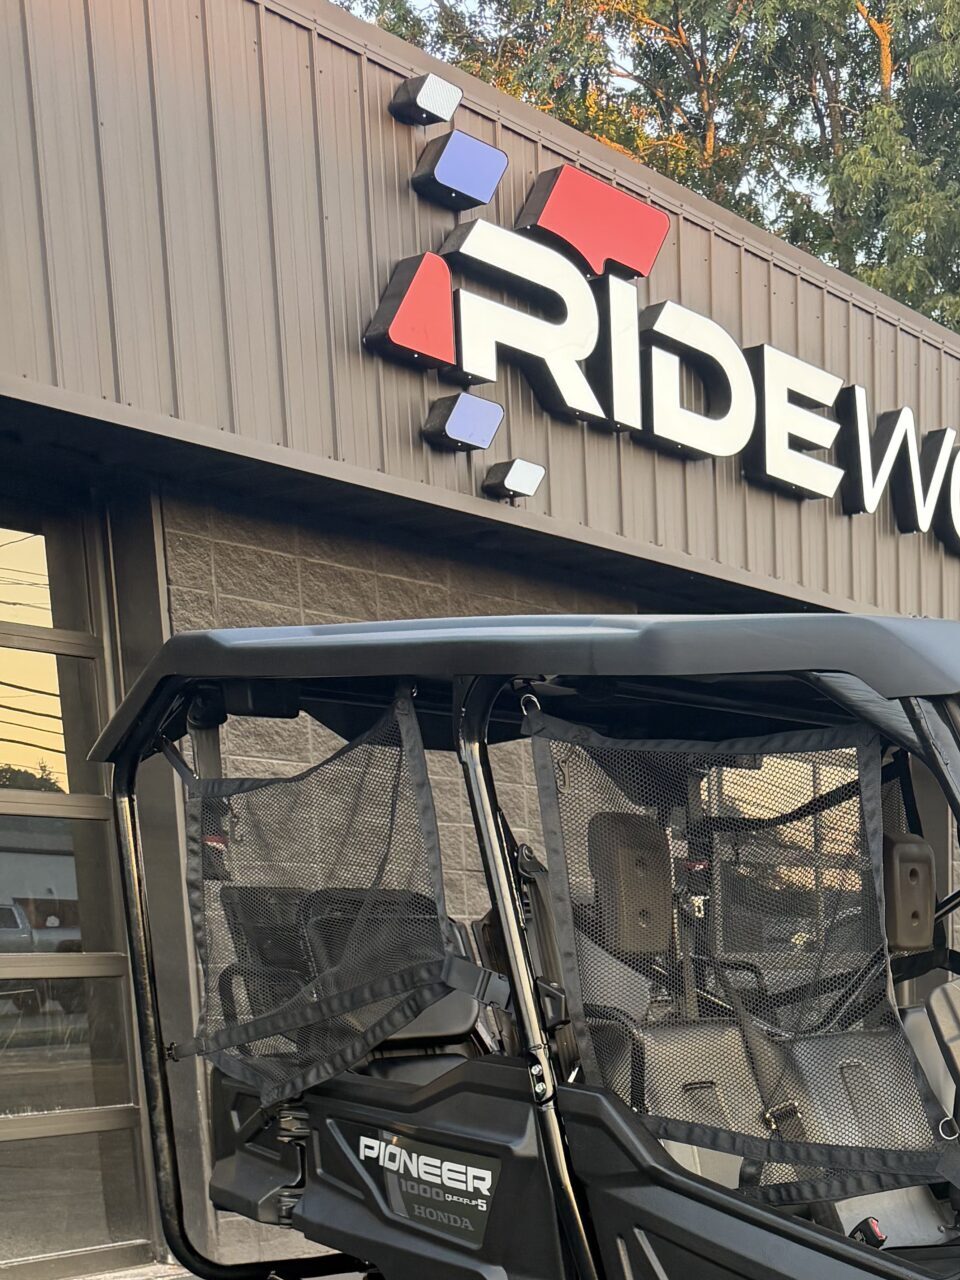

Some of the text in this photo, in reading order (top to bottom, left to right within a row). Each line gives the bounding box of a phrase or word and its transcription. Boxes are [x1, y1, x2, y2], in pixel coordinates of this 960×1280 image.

[359, 1135, 492, 1196] PIONEER
[401, 1179, 444, 1201] 1000
[413, 1205, 474, 1230] HONDA
